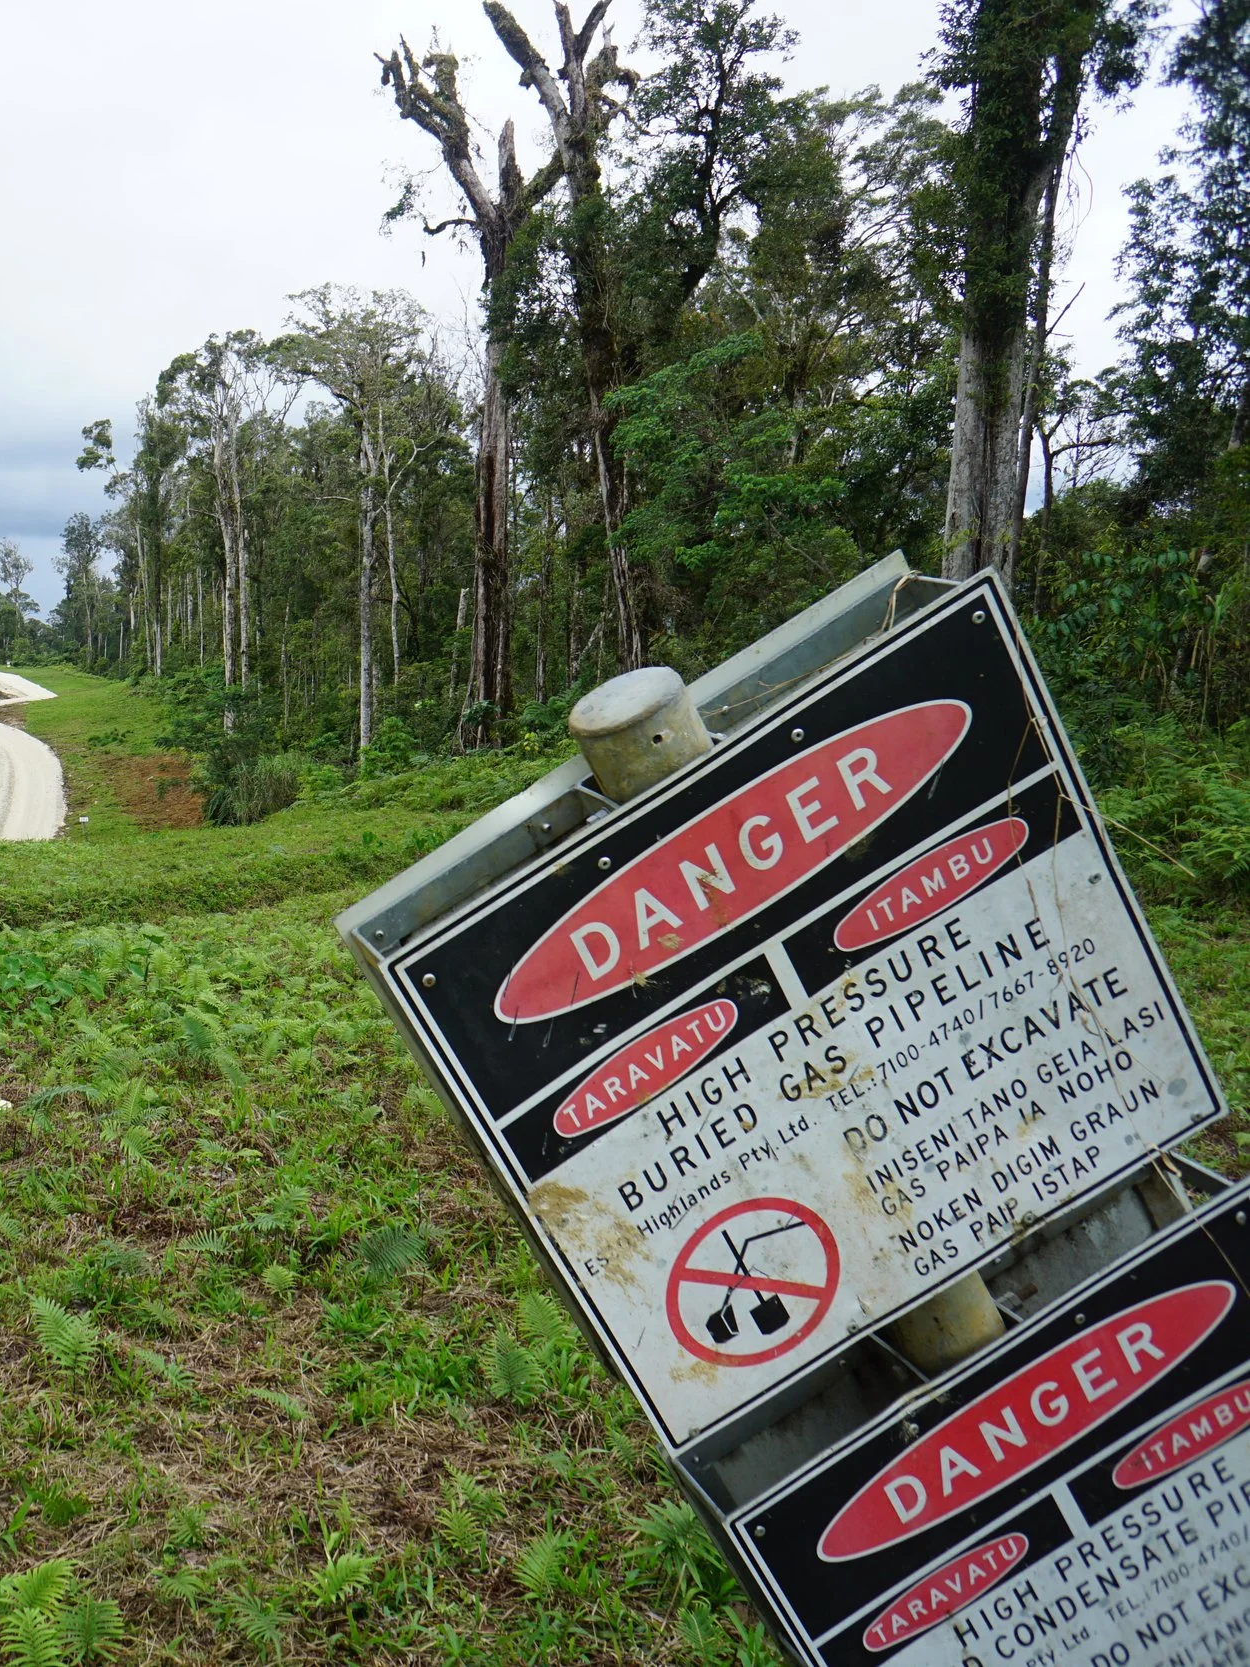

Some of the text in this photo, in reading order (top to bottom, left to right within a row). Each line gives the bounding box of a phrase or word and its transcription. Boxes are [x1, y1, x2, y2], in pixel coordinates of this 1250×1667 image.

[569, 747, 893, 982] DANGER
[866, 837, 993, 931] ITAMBU
[562, 1006, 726, 1128] TARAVATU
[617, 916, 1051, 1212] BURIED GAS PIPELINE
[656, 917, 972, 1137] HIGH PRESSURE
[842, 966, 1129, 1150] DO NOT EXCAVATE
[865, 1000, 1165, 1194] INISENI TANO GEIA LASI
[636, 1170, 732, 1237] Highlands
[881, 1050, 1133, 1216] GAS PAIPA IA NOHO
[898, 1078, 1160, 1254] NOKEN DIGIM GRAUN
[914, 1145, 1100, 1276] GAS PAIP ISTAP
[883, 1322, 1165, 1525] DANGER
[1140, 1390, 1250, 1471] ITAMBU
[871, 1535, 1019, 1644] TARAVATU
[952, 1456, 1235, 1651] HIGH PRESSURE
[994, 1518, 1199, 1659] CONDENSATE
[1135, 1600, 1190, 1650] NOT
